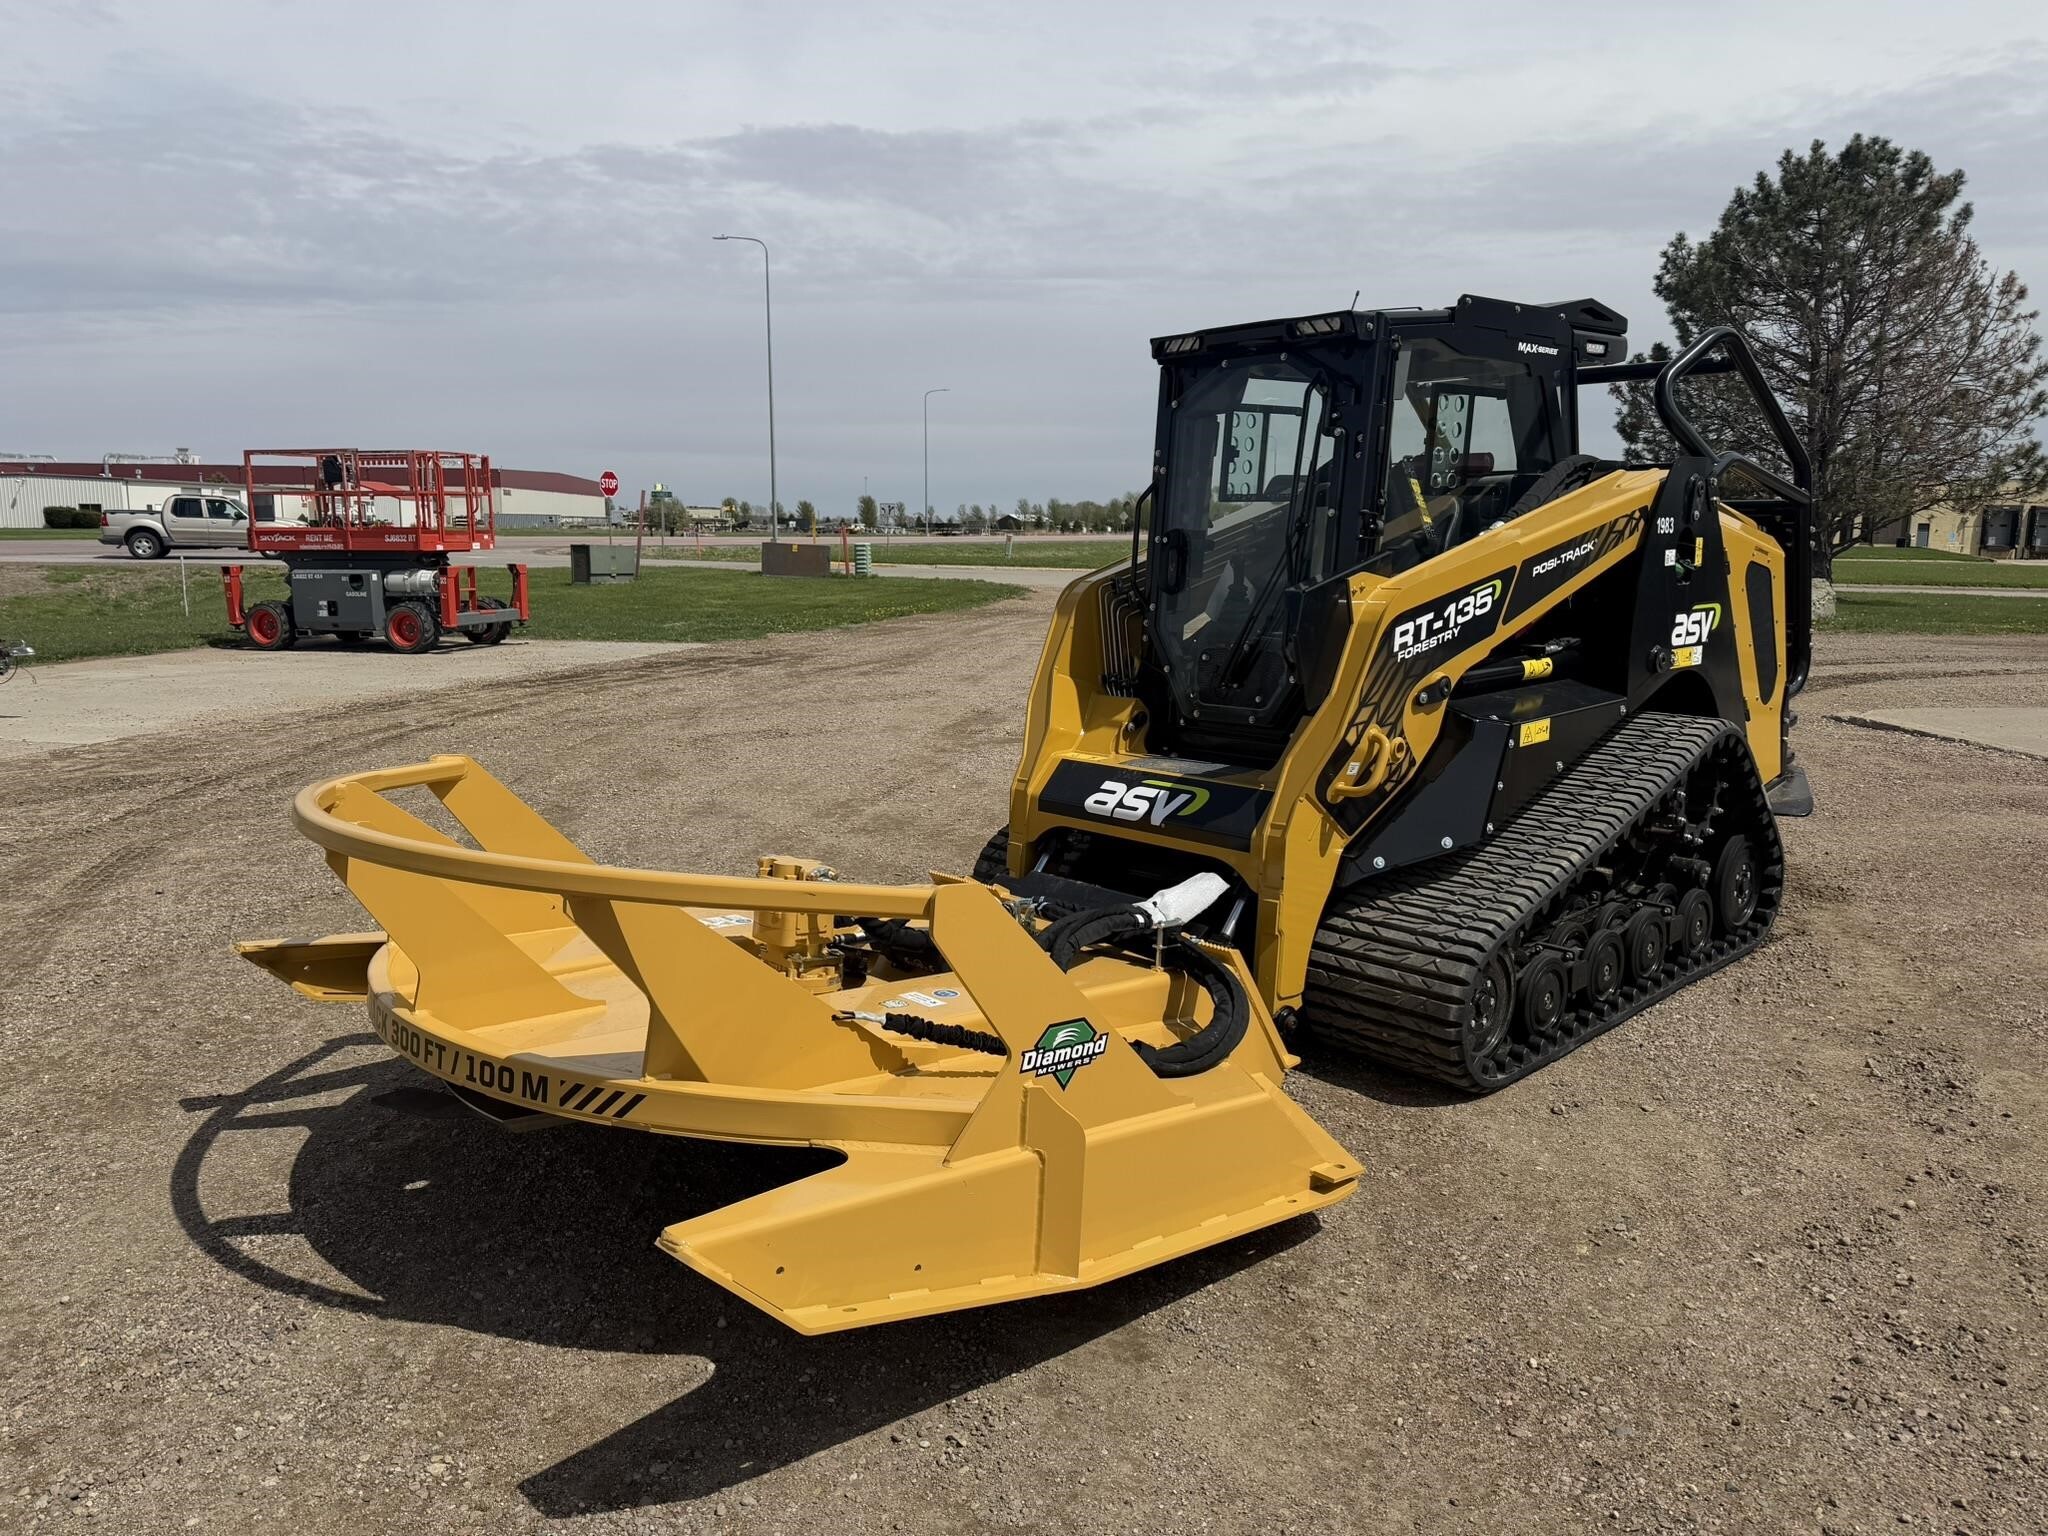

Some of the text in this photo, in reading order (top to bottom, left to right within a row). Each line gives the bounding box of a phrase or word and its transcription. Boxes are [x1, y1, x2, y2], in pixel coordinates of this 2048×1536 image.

[1518, 341, 1559, 356] MAX-SERIES
[601, 478, 618, 489] STOP
[260, 533, 296, 542] SKYJACK
[1656, 517, 1675, 534] 1983
[1532, 540, 1595, 577] POSI-TRACK
[1393, 587, 1493, 653] RT-135
[1397, 625, 1462, 663] FORESTRY
[391, 1019, 421, 1058] 300
[423, 1039, 447, 1070] FT
[465, 1055, 515, 1094] 100
[521, 1072, 548, 1104] M
[1021, 1034, 1107, 1071] Diamond
[1037, 1056, 1090, 1075] MOWERS
